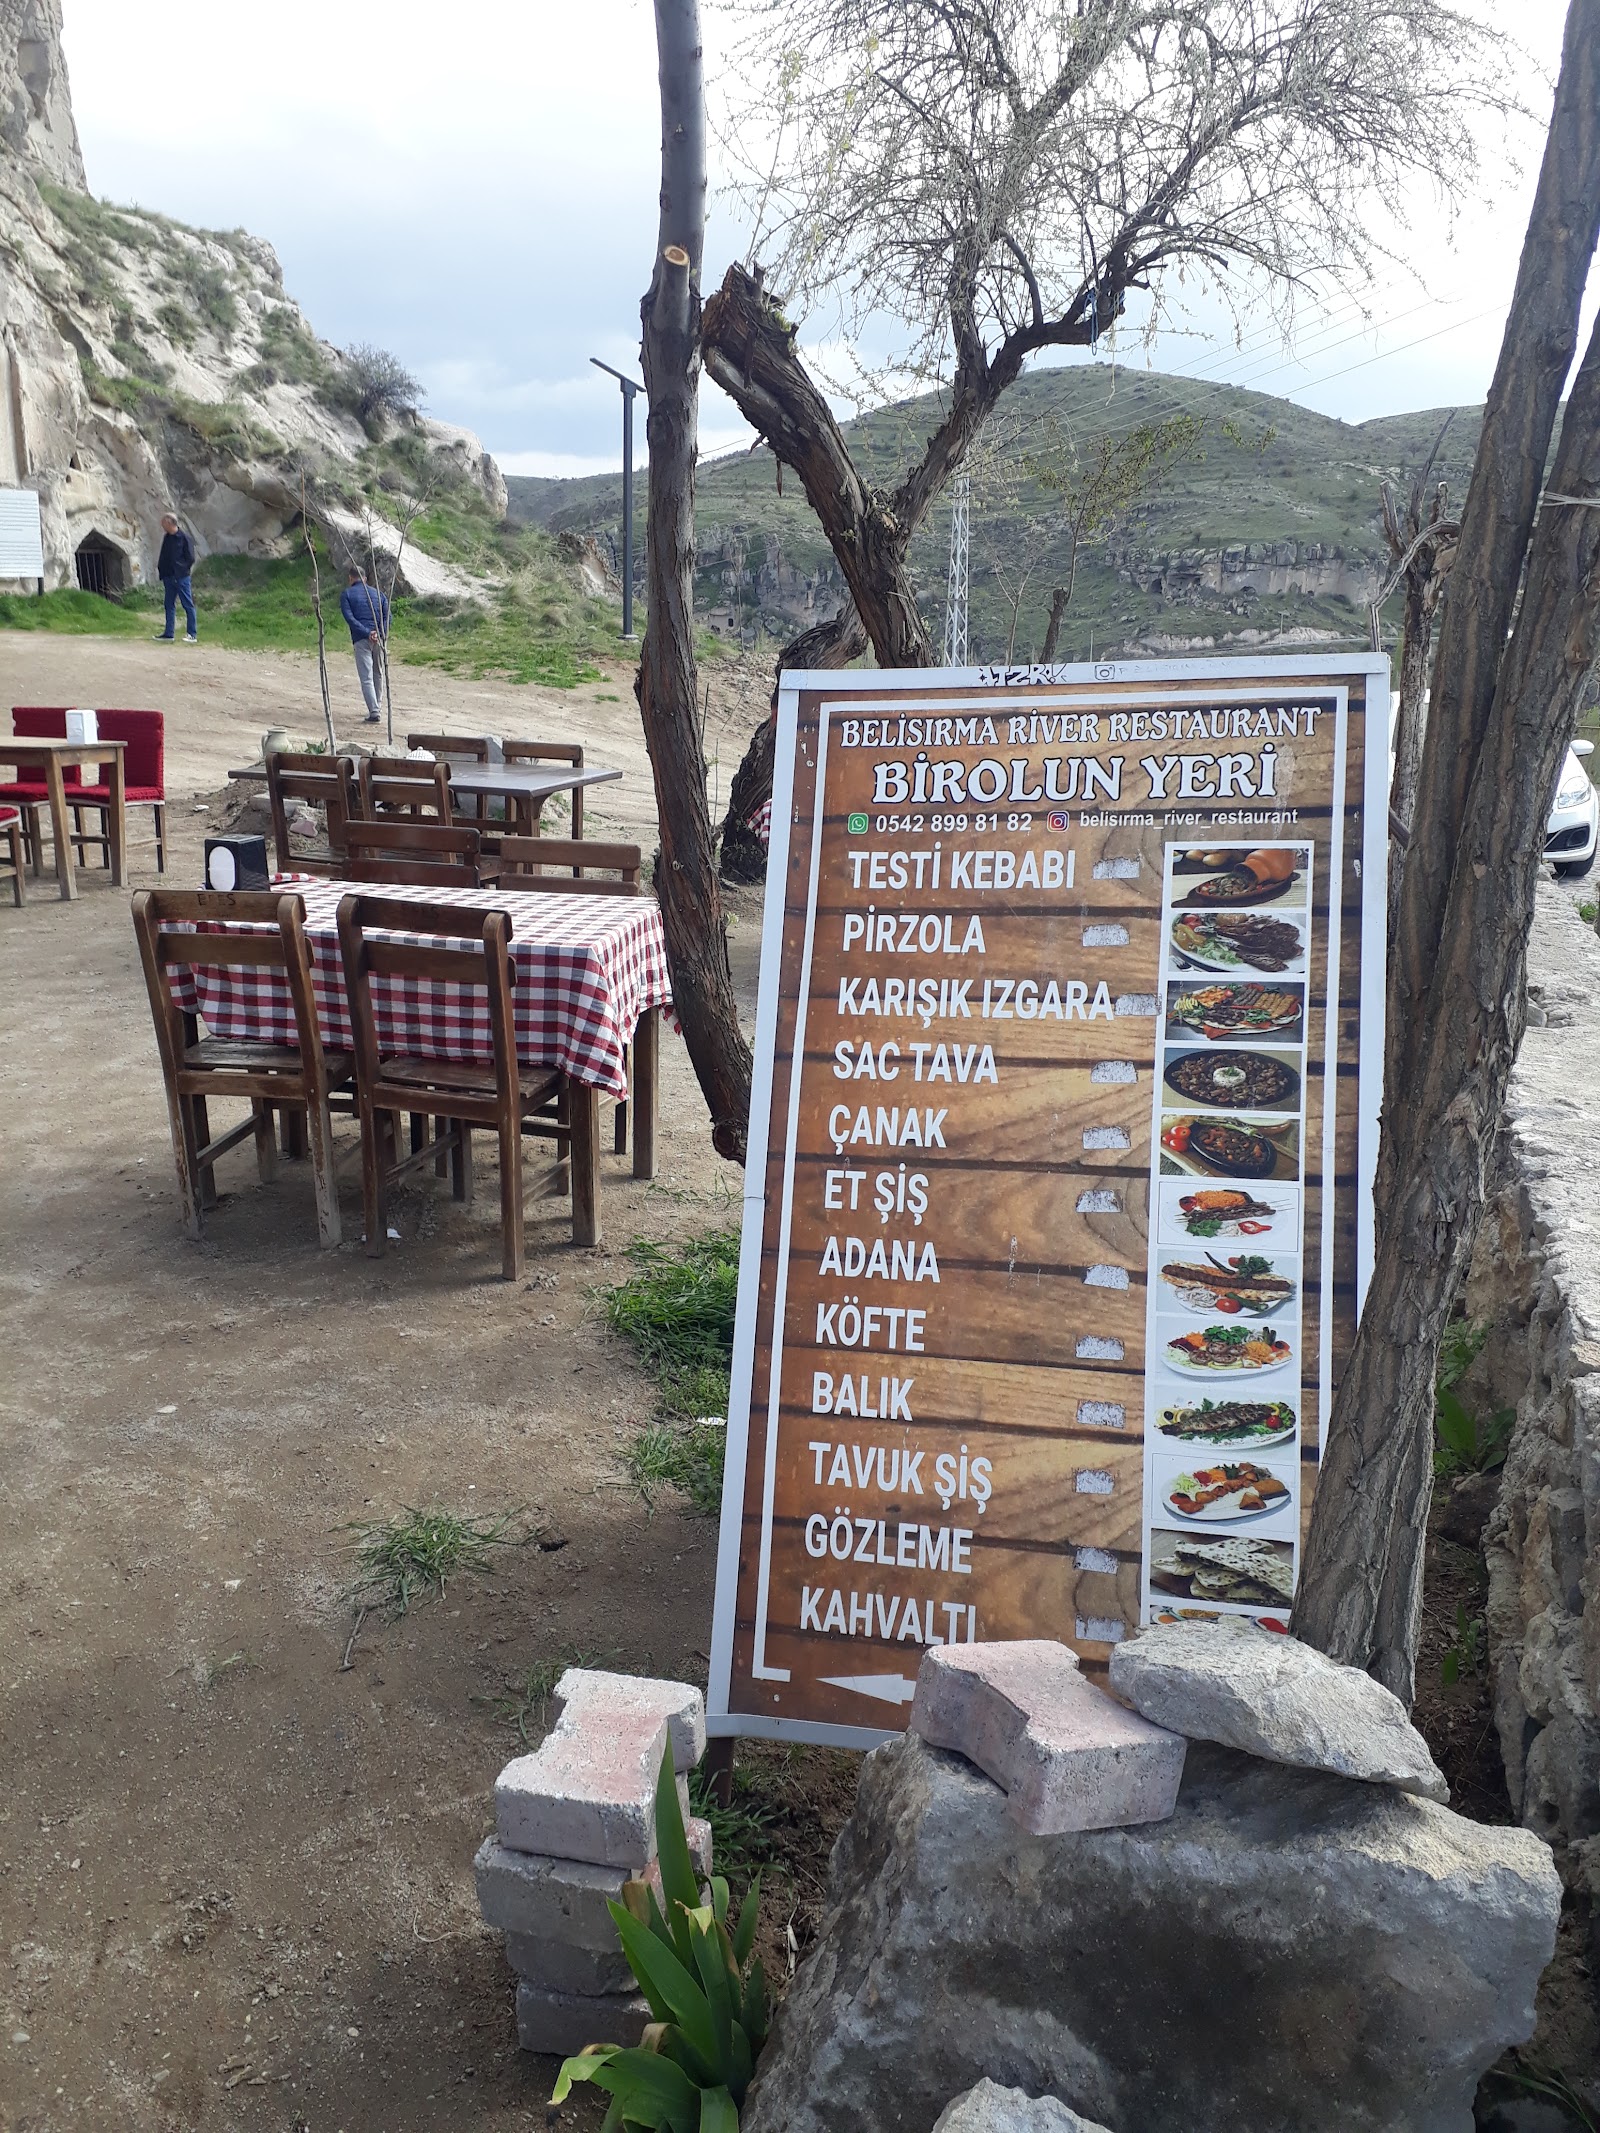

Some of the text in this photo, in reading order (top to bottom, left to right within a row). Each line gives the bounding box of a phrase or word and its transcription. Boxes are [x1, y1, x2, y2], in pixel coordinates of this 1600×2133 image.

[840, 706, 1322, 747] BELİSIRMA RİVER RESTAURANT
[871, 742, 1278, 804] BİROLUN YERİ
[876, 814, 924, 833] 0542
[930, 814, 968, 832] 899
[974, 813, 998, 832] 81
[1006, 813, 1032, 831] 82
[847, 841, 1076, 890] TESTİ KEBABI
[842, 904, 987, 954] PİRZOLA
[837, 976, 1115, 1030] KARIŞIK IZGARA
[832, 1040, 999, 1084] SAC TAVA
[828, 1104, 949, 1156] ÇANAK
[824, 1162, 929, 1226] ET ŞİŞ
[818, 1235, 941, 1283] ADANA
[815, 1295, 927, 1352] KÖFTE
[812, 1371, 915, 1421] BALIK
[808, 1441, 993, 1515] TAVUK ŞİŞ
[805, 1506, 974, 1574] GÖZLEME
[800, 1586, 976, 1645] KAHVALTI
